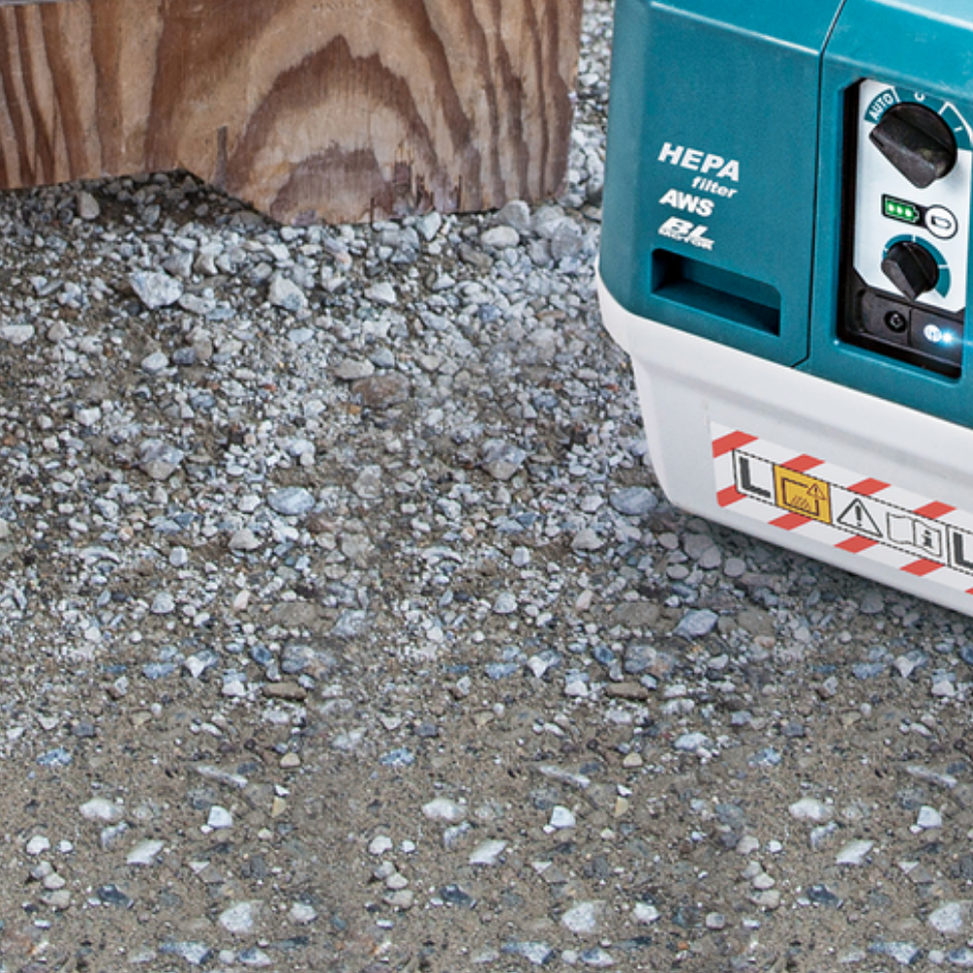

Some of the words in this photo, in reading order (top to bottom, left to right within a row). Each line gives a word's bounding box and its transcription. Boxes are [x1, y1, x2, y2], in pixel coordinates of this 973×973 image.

[868, 93, 894, 121] AUTO
[657, 142, 740, 182] HEPA
[692, 176, 738, 198] filter
[659, 188, 715, 217] AWS
